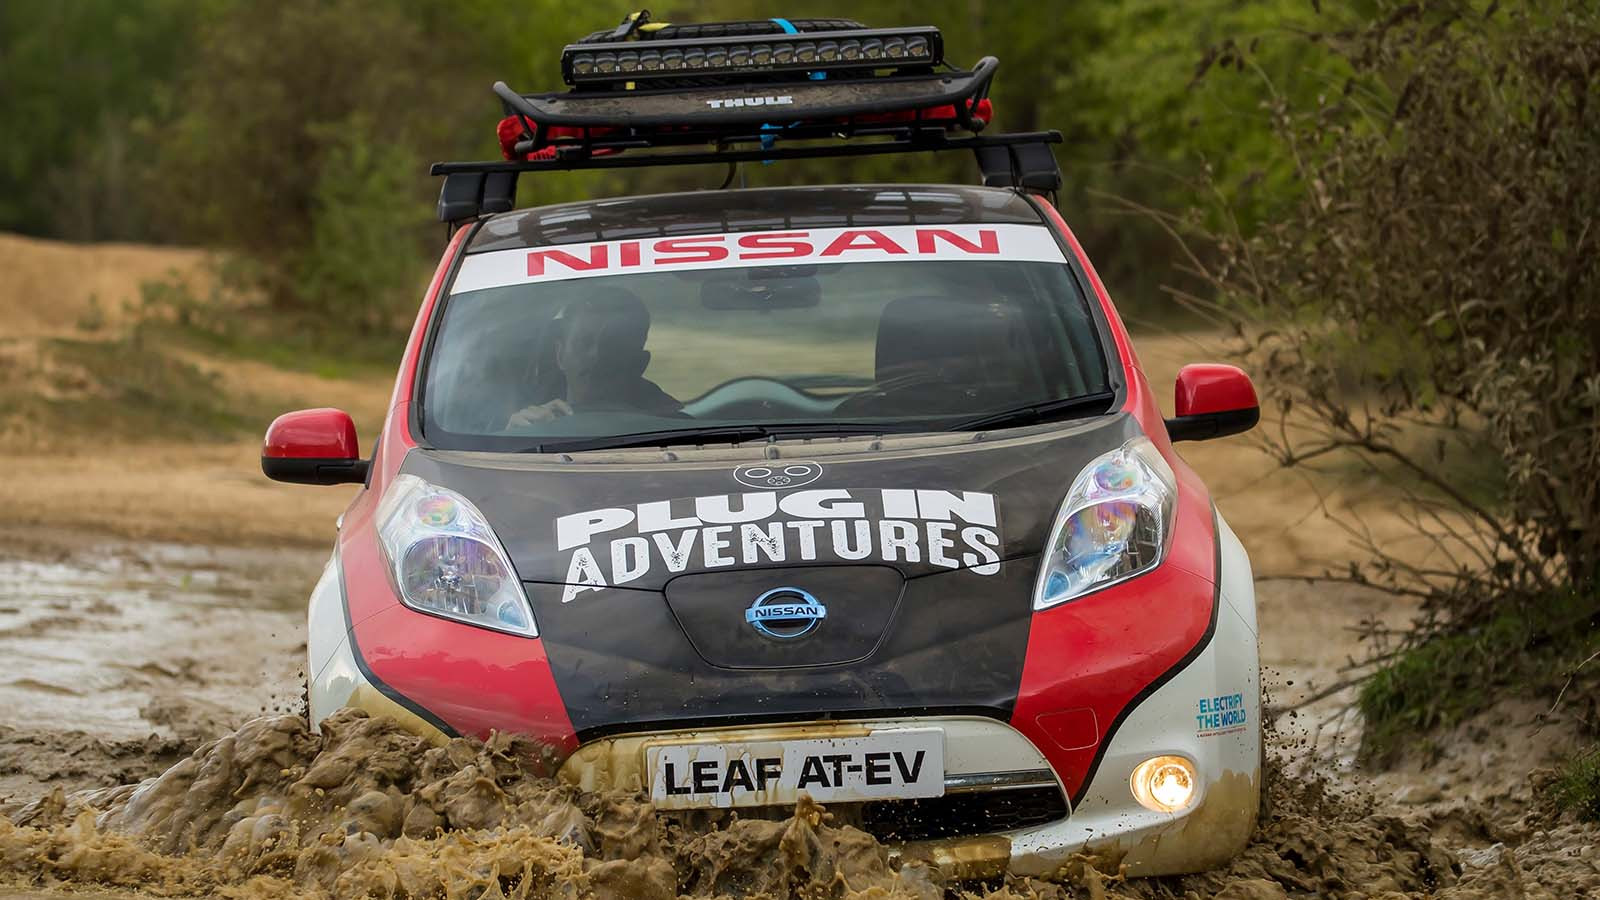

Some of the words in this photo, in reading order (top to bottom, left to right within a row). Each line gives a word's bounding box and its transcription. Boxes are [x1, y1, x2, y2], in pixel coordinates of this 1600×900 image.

[706, 96, 793, 108] THULE
[526, 229, 1001, 277] NISSAN
[556, 489, 867, 552] PLUG
[880, 489, 998, 527] IN
[561, 520, 1001, 603] ADVENTURES
[755, 607, 818, 618] NISSAN
[1196, 714, 1220, 729] THE
[1220, 709, 1247, 727] WORLD
[1199, 693, 1243, 714] ELECTRIFY
[664, 757, 782, 796] LEAF
[797, 750, 927, 790] AT-EV
